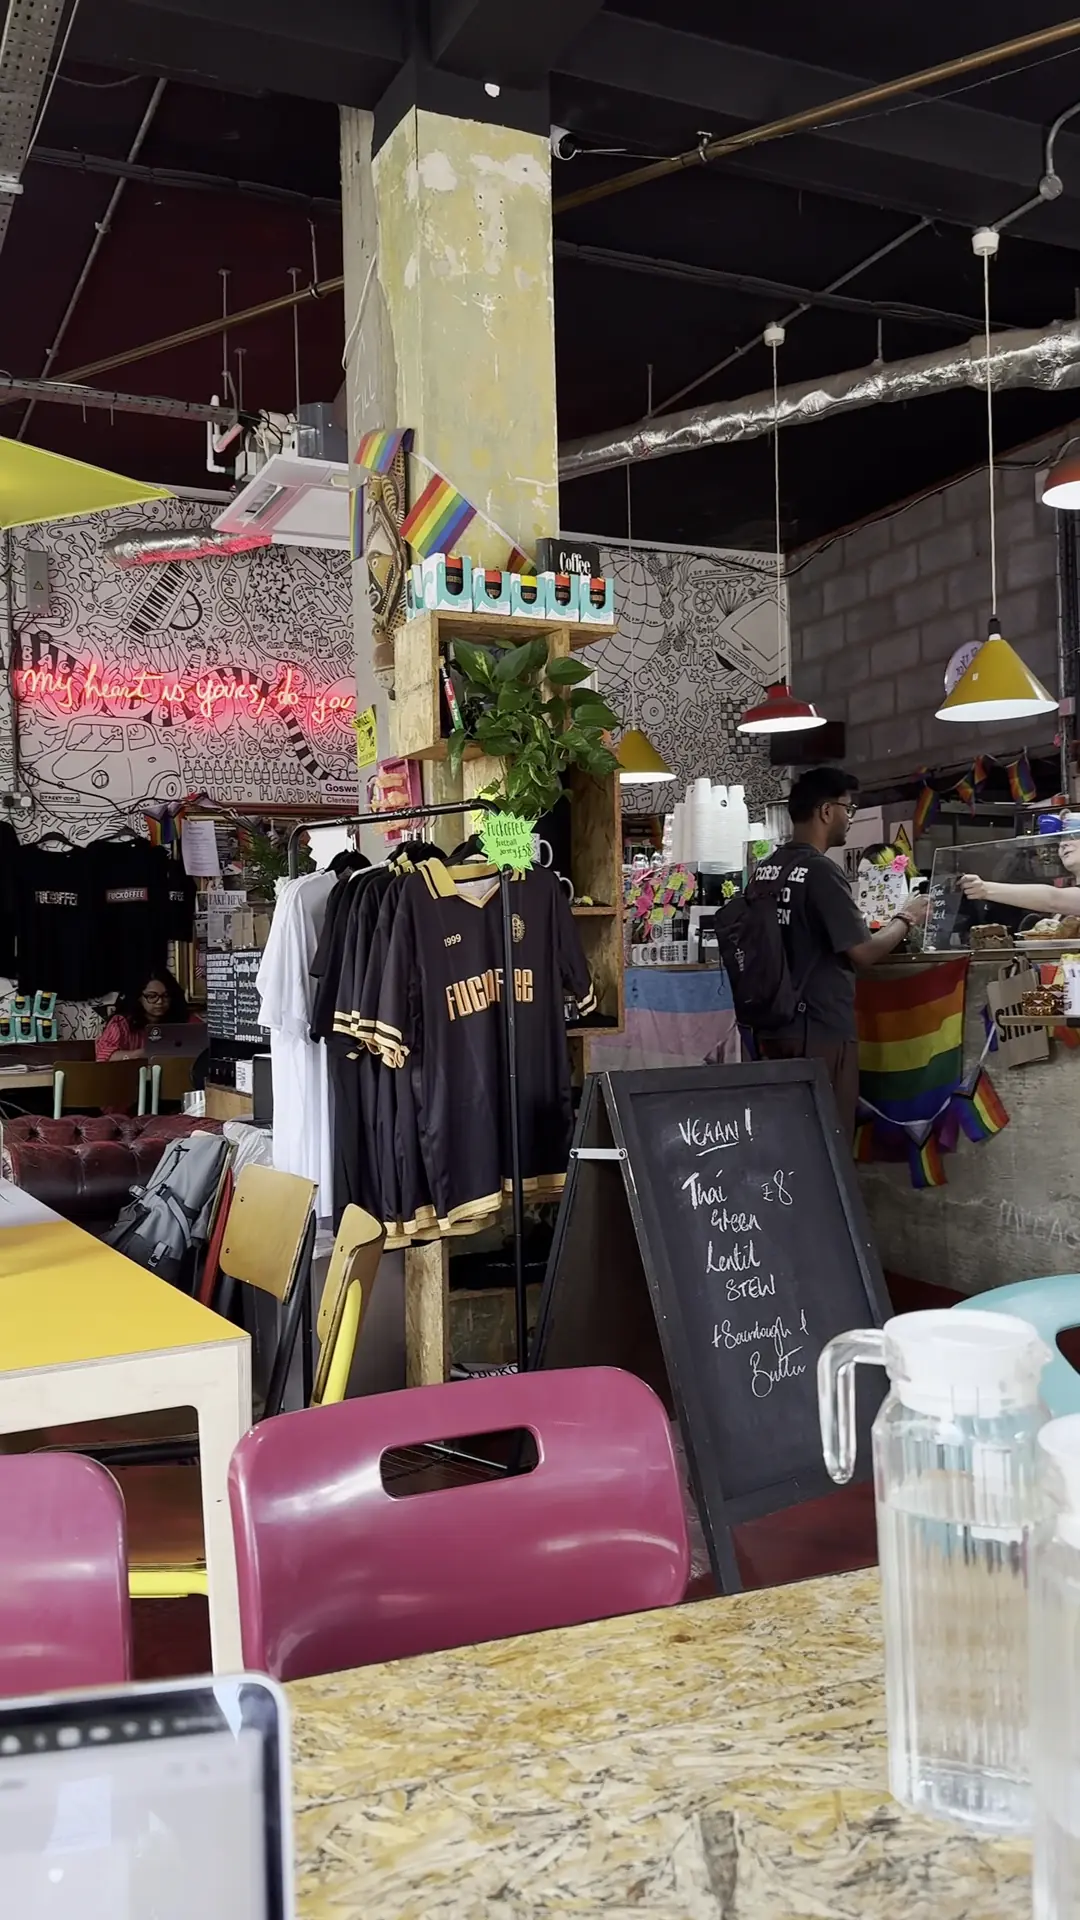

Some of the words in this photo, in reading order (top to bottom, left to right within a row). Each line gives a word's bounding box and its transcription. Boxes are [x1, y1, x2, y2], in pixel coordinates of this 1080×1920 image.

[559, 551, 591, 575] Coffee
[82, 664, 164, 699] heart
[161, 683, 185, 701] is
[196, 679, 266, 718] yours,
[277, 668, 300, 706] do
[311, 695, 354, 725] you
[443, 933, 462, 947] 1999
[681, 1168, 728, 1210] Thai
[710, 1208, 762, 1233] Green
[706, 1239, 761, 1274] Lentil
[725, 1273, 776, 1302] STEW
[750, 1345, 807, 1399] Butter
